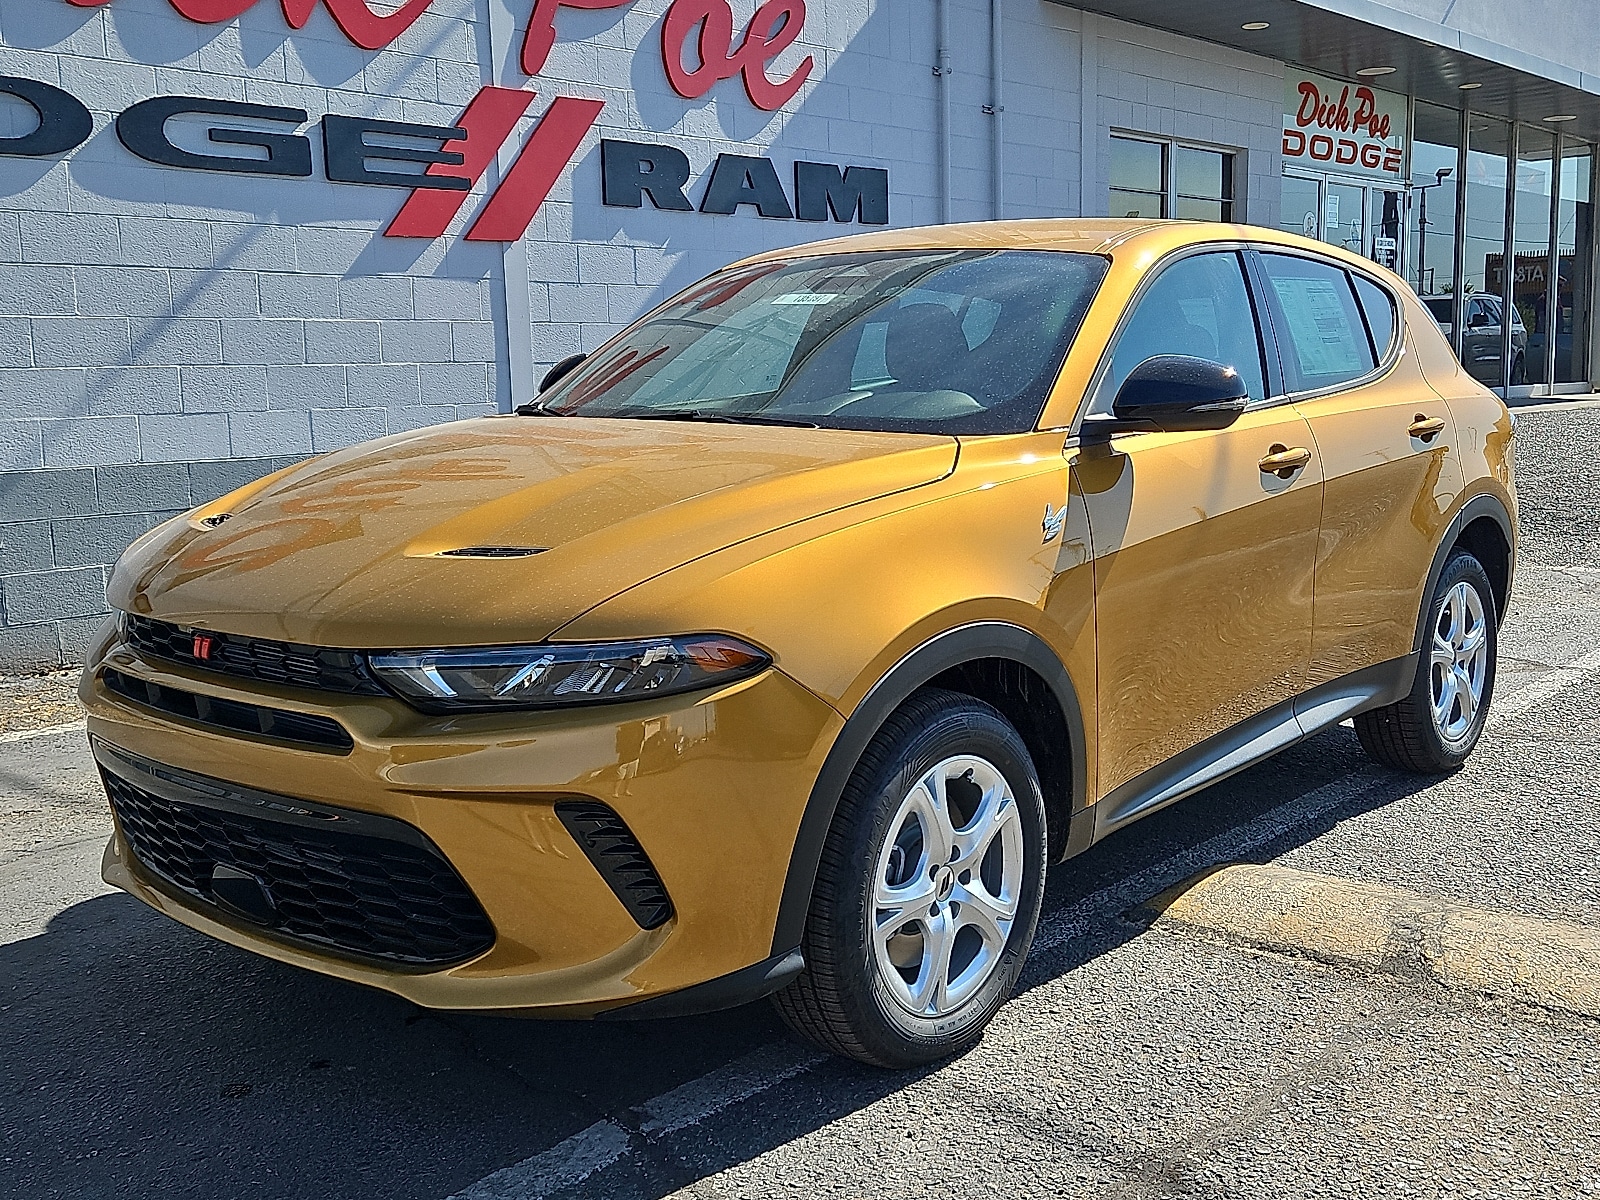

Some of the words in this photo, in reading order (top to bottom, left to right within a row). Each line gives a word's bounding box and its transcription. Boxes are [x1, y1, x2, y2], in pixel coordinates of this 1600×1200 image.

[1296, 81, 1350, 133] Dick
[1352, 86, 1391, 140] Poe
[1281, 128, 1403, 173] DODGE
[601, 138, 889, 225] RAM
